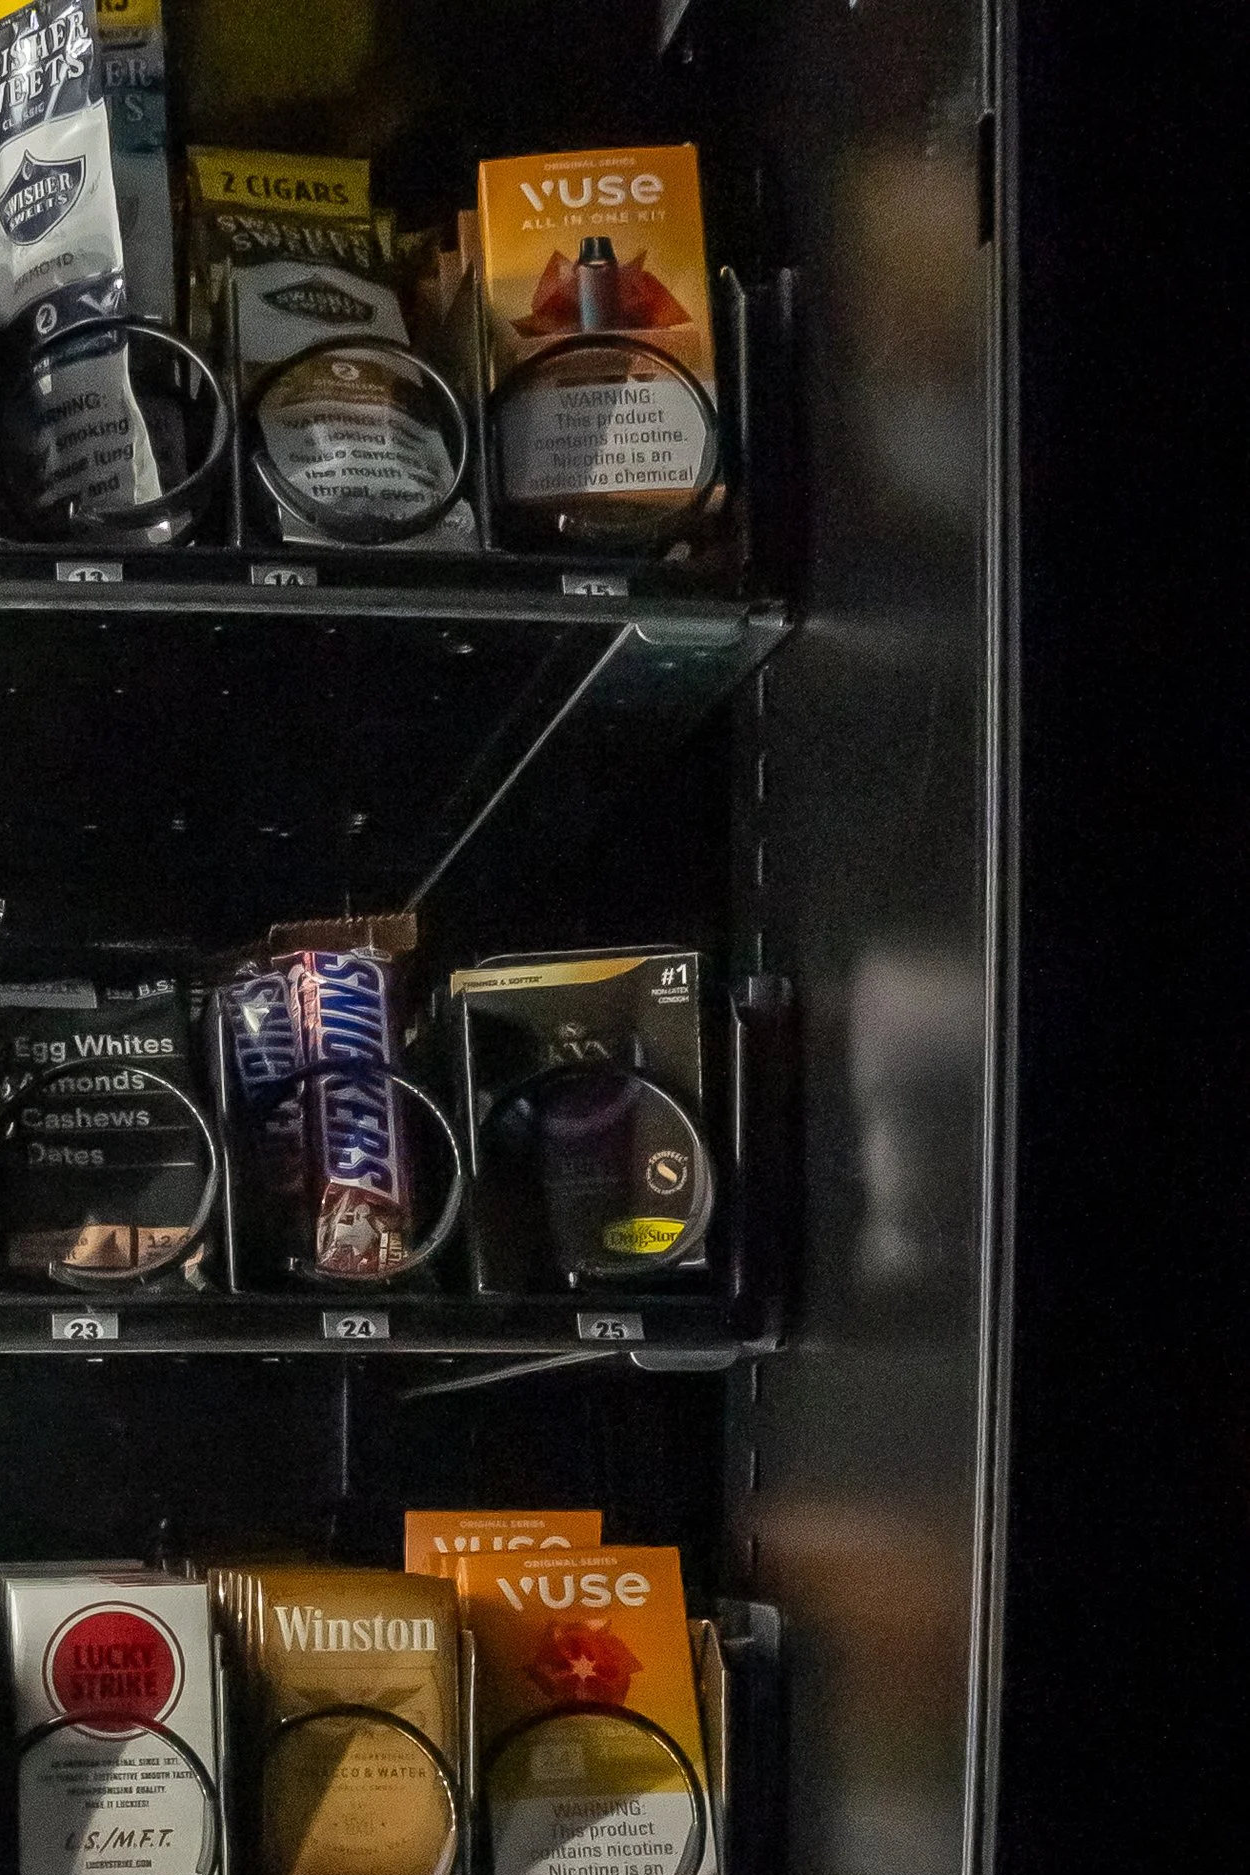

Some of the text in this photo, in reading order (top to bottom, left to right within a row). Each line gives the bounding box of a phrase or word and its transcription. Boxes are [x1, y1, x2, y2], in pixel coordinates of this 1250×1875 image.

[221, 171, 348, 204] 2 CIGARS
[522, 210, 666, 231] ALL IN ONE KIT
[602, 410, 664, 427] product
[613, 429, 688, 444] nicotine.
[615, 466, 693, 483] chemical
[661, 963, 688, 986] #1
[14, 1034, 174, 1063] Egg Whites
[21, 1107, 150, 1129] Cashews
[70, 1322, 100, 1339] 23
[342, 1320, 372, 1337] 24
[596, 1323, 625, 1338] 25
[274, 1605, 438, 1651] Winston
[378, 1767, 427, 1778] WATER
[589, 1822, 655, 1839] product
[606, 1841, 678, 1858] nicotine.
